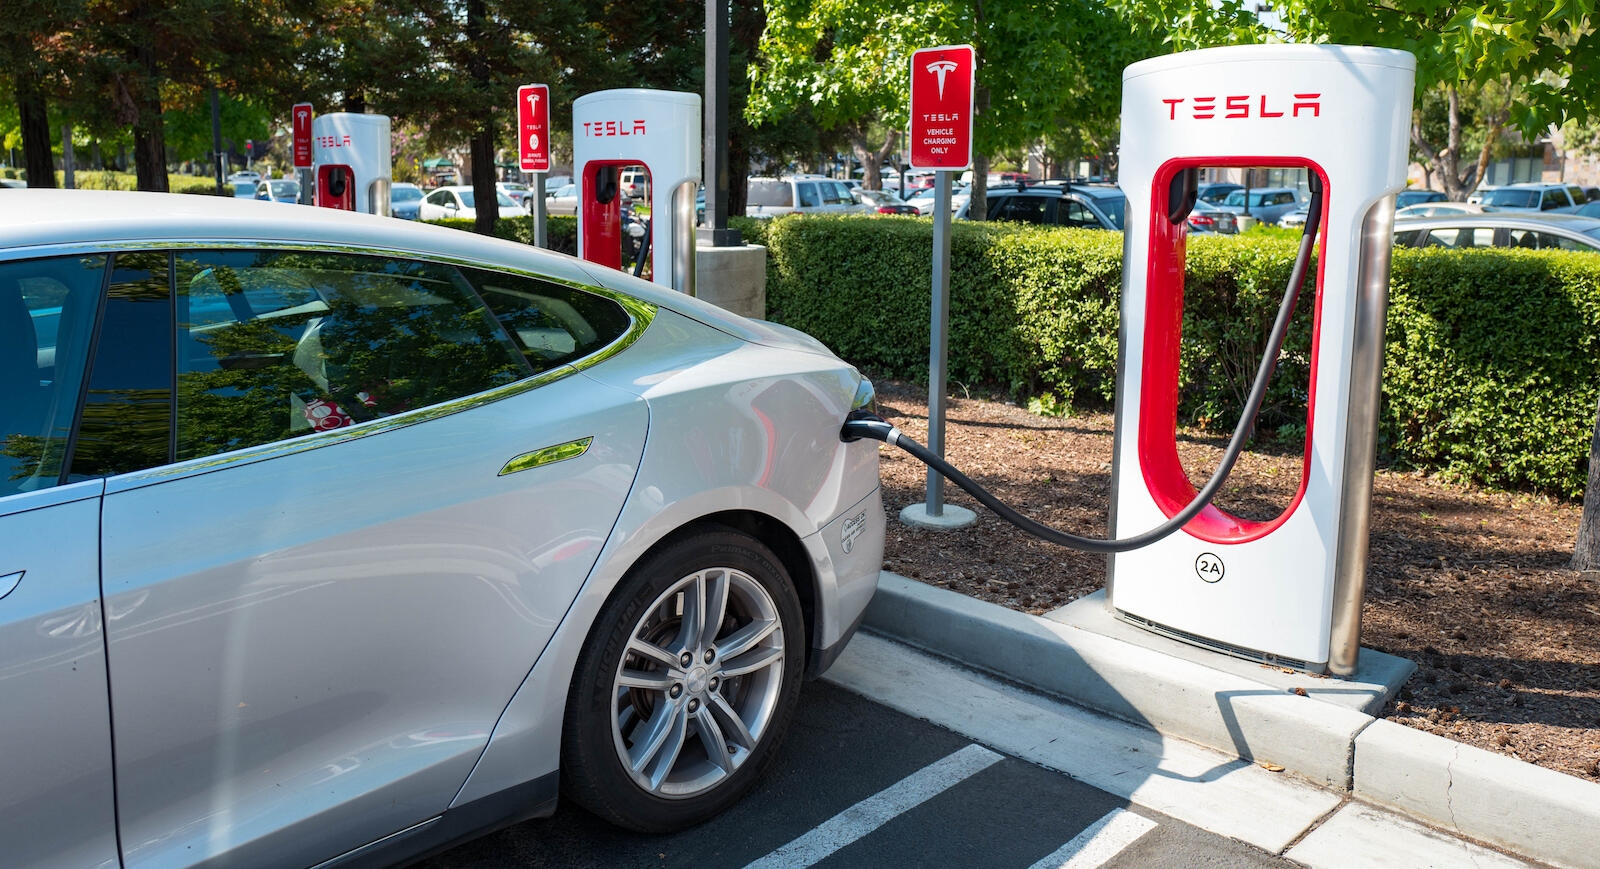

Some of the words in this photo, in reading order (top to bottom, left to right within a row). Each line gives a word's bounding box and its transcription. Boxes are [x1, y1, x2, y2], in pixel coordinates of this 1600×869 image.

[1162, 93, 1321, 120] TESLA
[923, 113, 959, 121] TESLA
[584, 120, 645, 136] TESLA
[317, 135, 351, 148] TESLA
[1201, 560, 1220, 575] 2A
